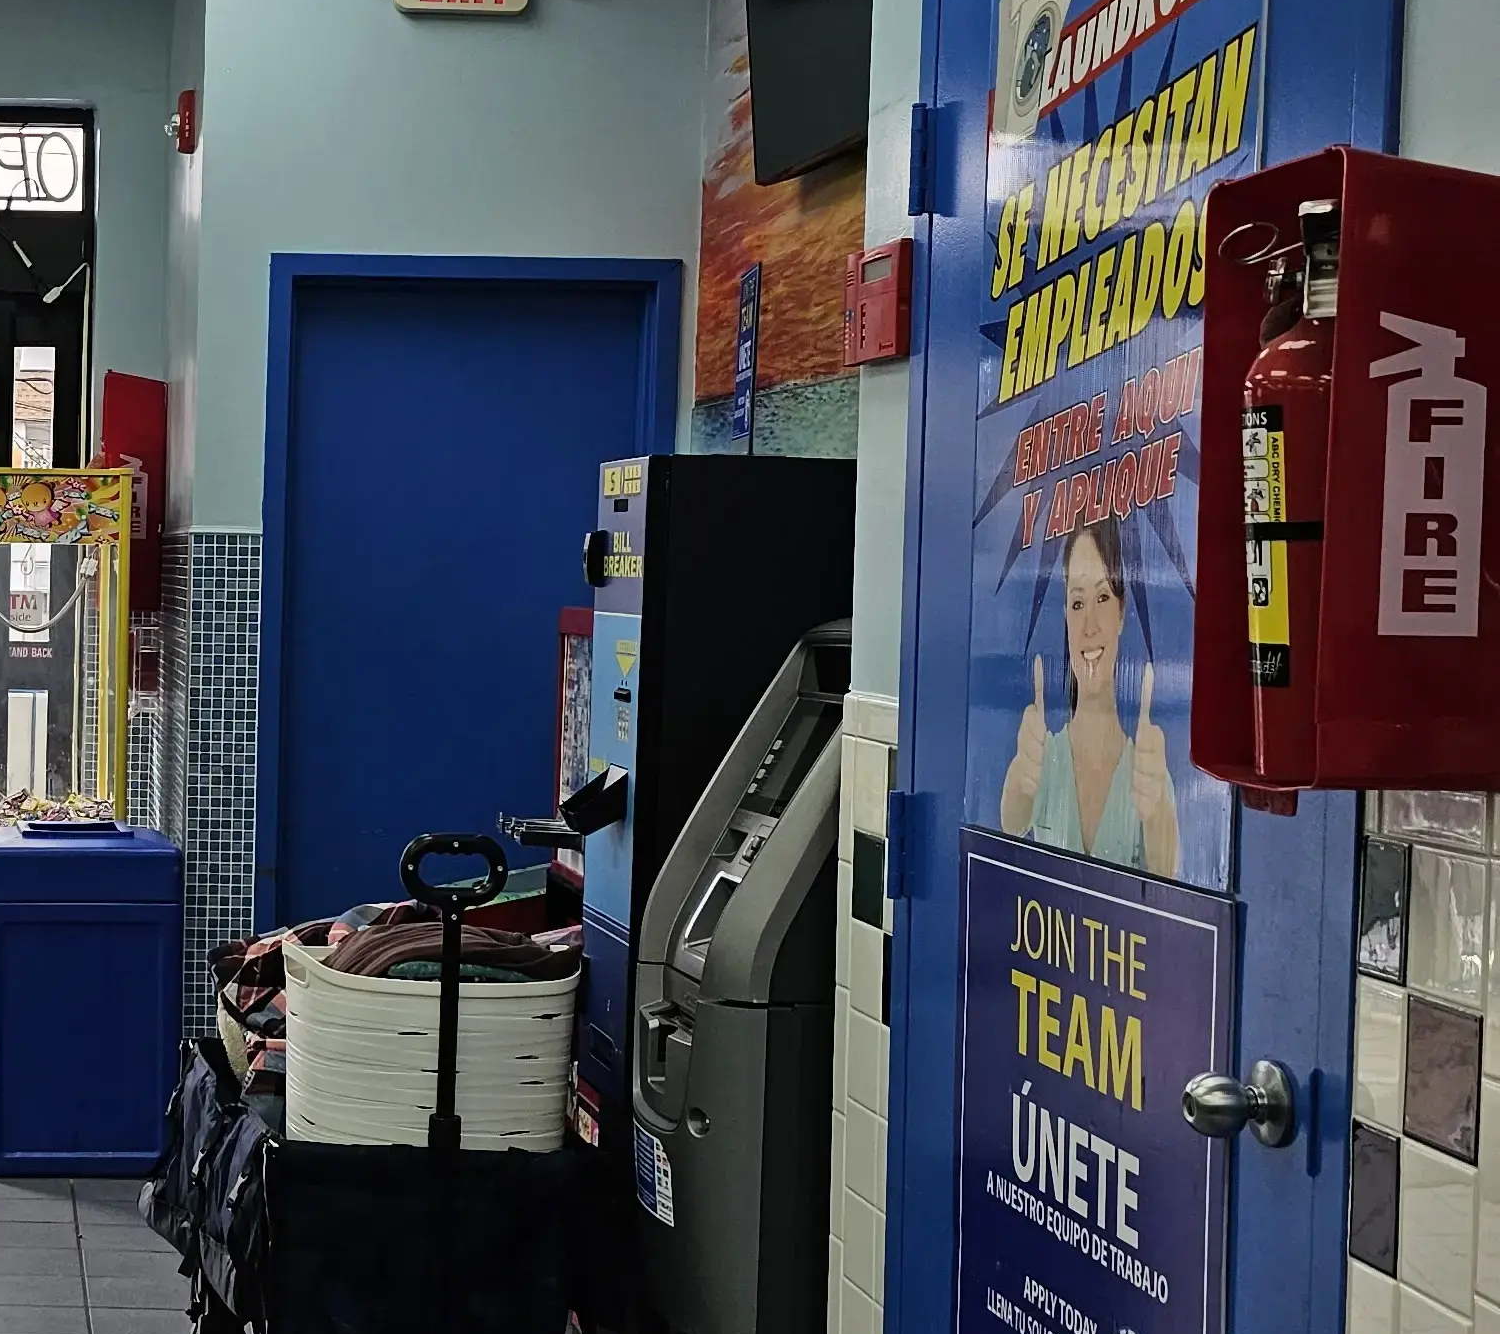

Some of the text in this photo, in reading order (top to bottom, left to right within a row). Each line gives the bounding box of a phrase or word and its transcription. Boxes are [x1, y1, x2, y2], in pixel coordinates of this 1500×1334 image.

[990, 21, 1260, 301] SE NECESITAN
[996, 194, 1208, 405] EMPLEADOS
[1013, 345, 1203, 487] ENTRE AQUI
[131, 477, 143, 533] FIRE
[1021, 430, 1182, 550] Y APLIQUE
[1271, 437, 1281, 522] ABC DRY CHEMI
[1401, 399, 1464, 613] FIRE
[604, 555, 643, 578] BREAKER
[613, 531, 631, 553] BILL
[10, 594, 37, 610] TM
[10, 613, 31, 622] side
[10, 647, 53, 658] AND BACK
[1010, 895, 1147, 1001] JOIN THE
[1011, 968, 1142, 1112] TEAM
[1012, 1079, 1140, 1250] ÚNETE
[986, 1170, 1168, 1304] A NUESTRO EQUIPO DE TRABAJO
[987, 1286, 1013, 1328] LLENA
[1023, 1275, 1058, 1319] APPLY
